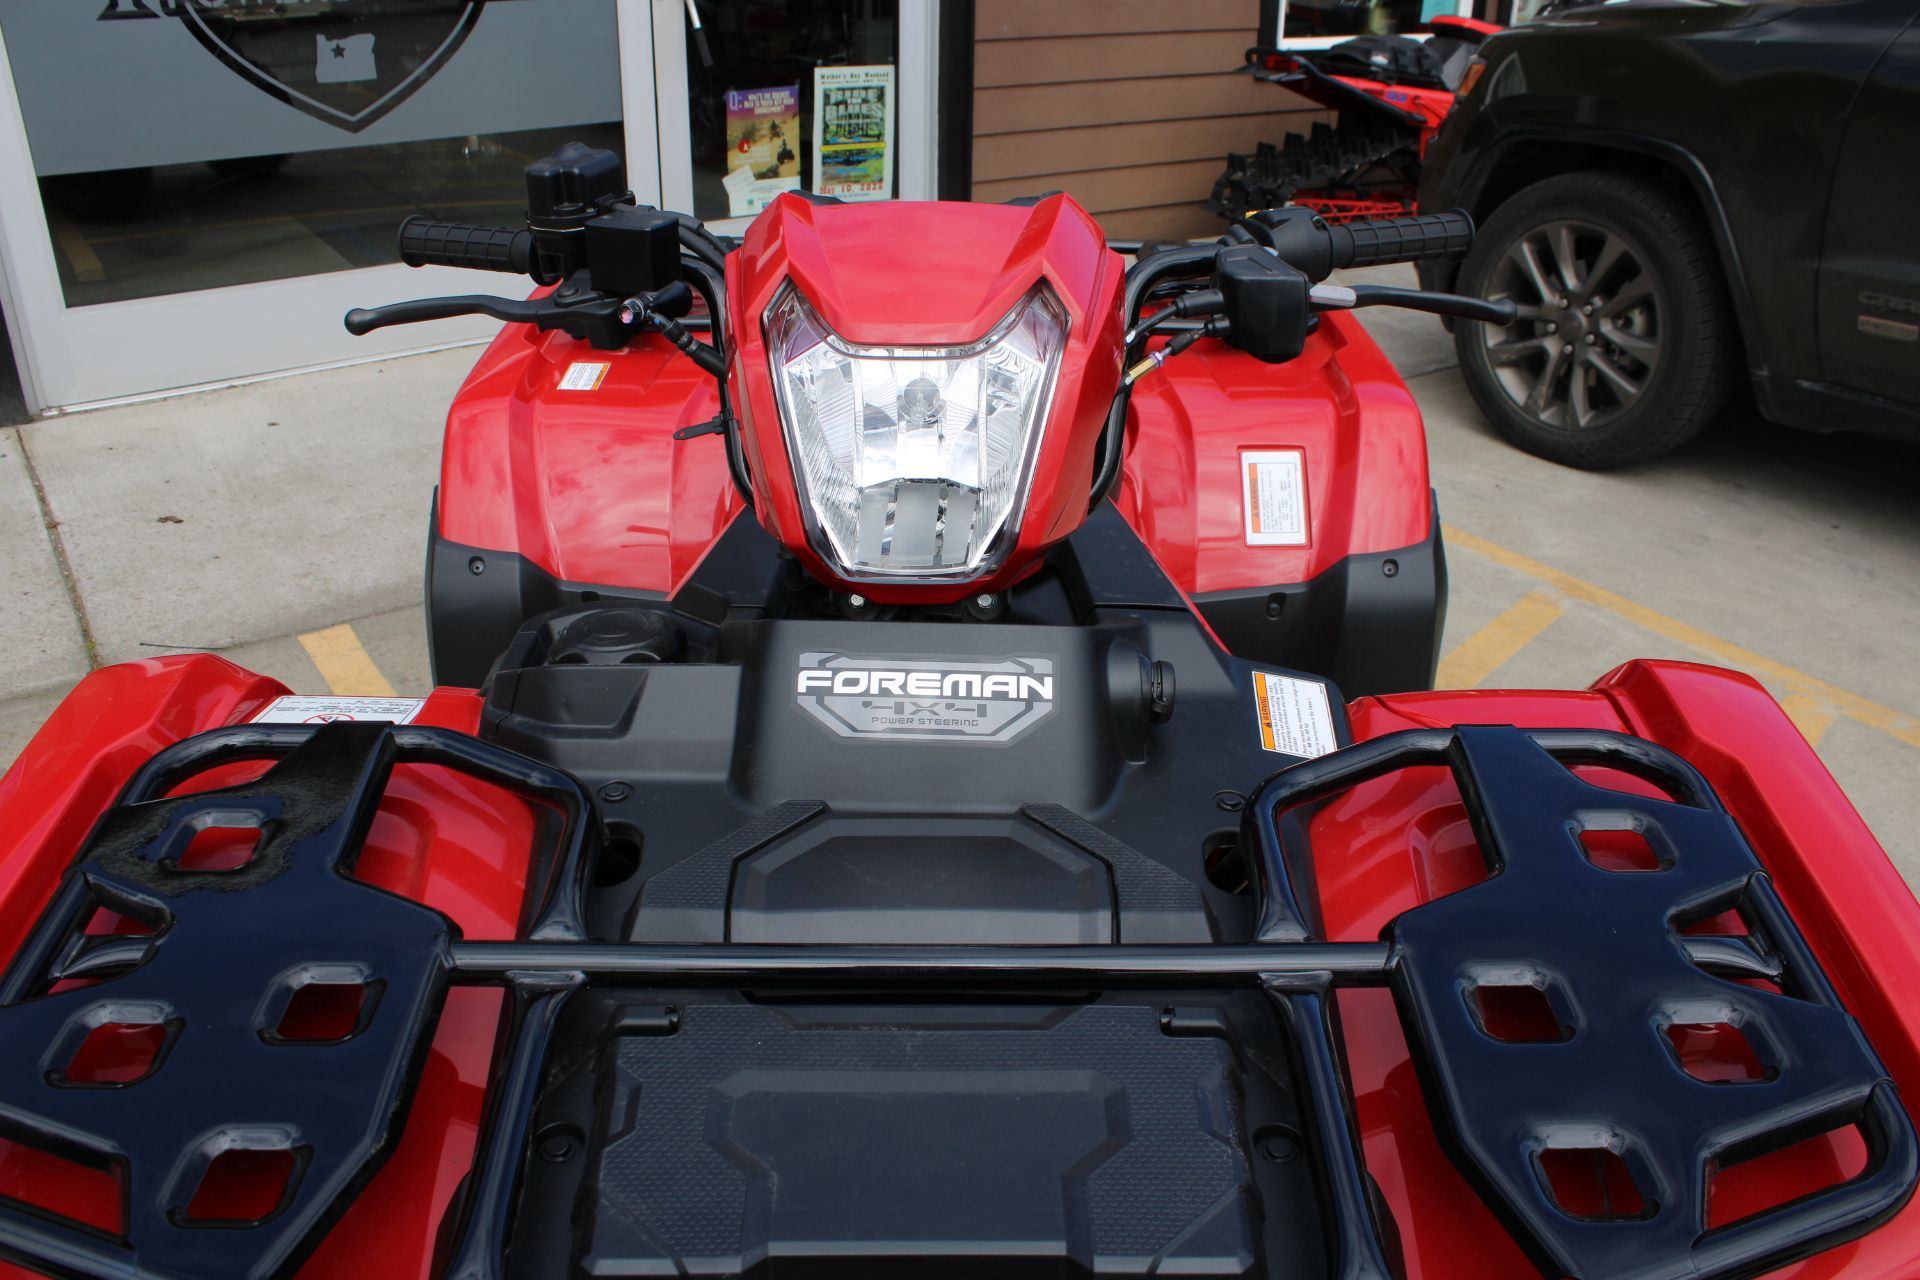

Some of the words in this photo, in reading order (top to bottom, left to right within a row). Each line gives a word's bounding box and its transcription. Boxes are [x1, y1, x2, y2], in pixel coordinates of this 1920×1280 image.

[850, 72, 861, 80] Day
[819, 185, 835, 194] May
[797, 670, 1053, 699] FOREMAN
[871, 716, 914, 726] POWER
[918, 717, 979, 727] STEERING
